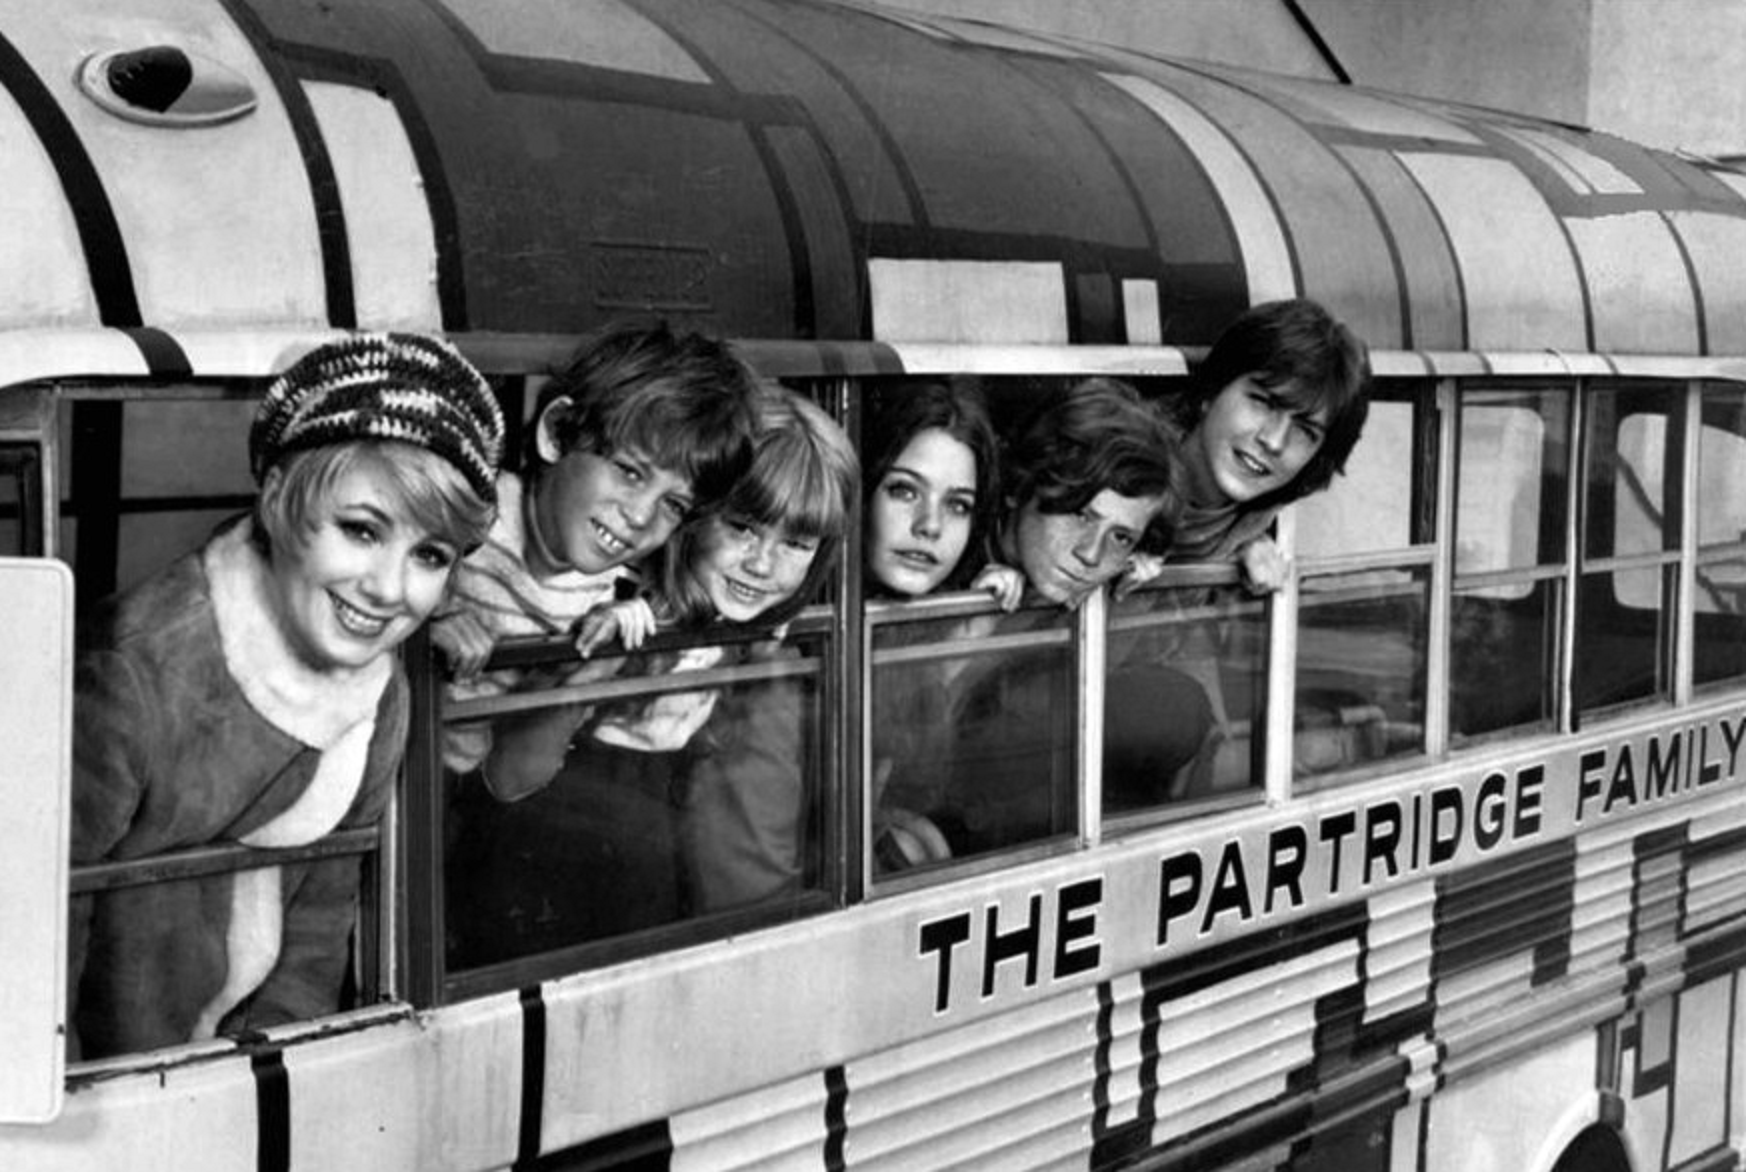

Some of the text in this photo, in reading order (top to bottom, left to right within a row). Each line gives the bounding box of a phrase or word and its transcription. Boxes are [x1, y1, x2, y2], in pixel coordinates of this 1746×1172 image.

[919, 717, 1746, 1012] THE PARTRIDGE FAMILY
